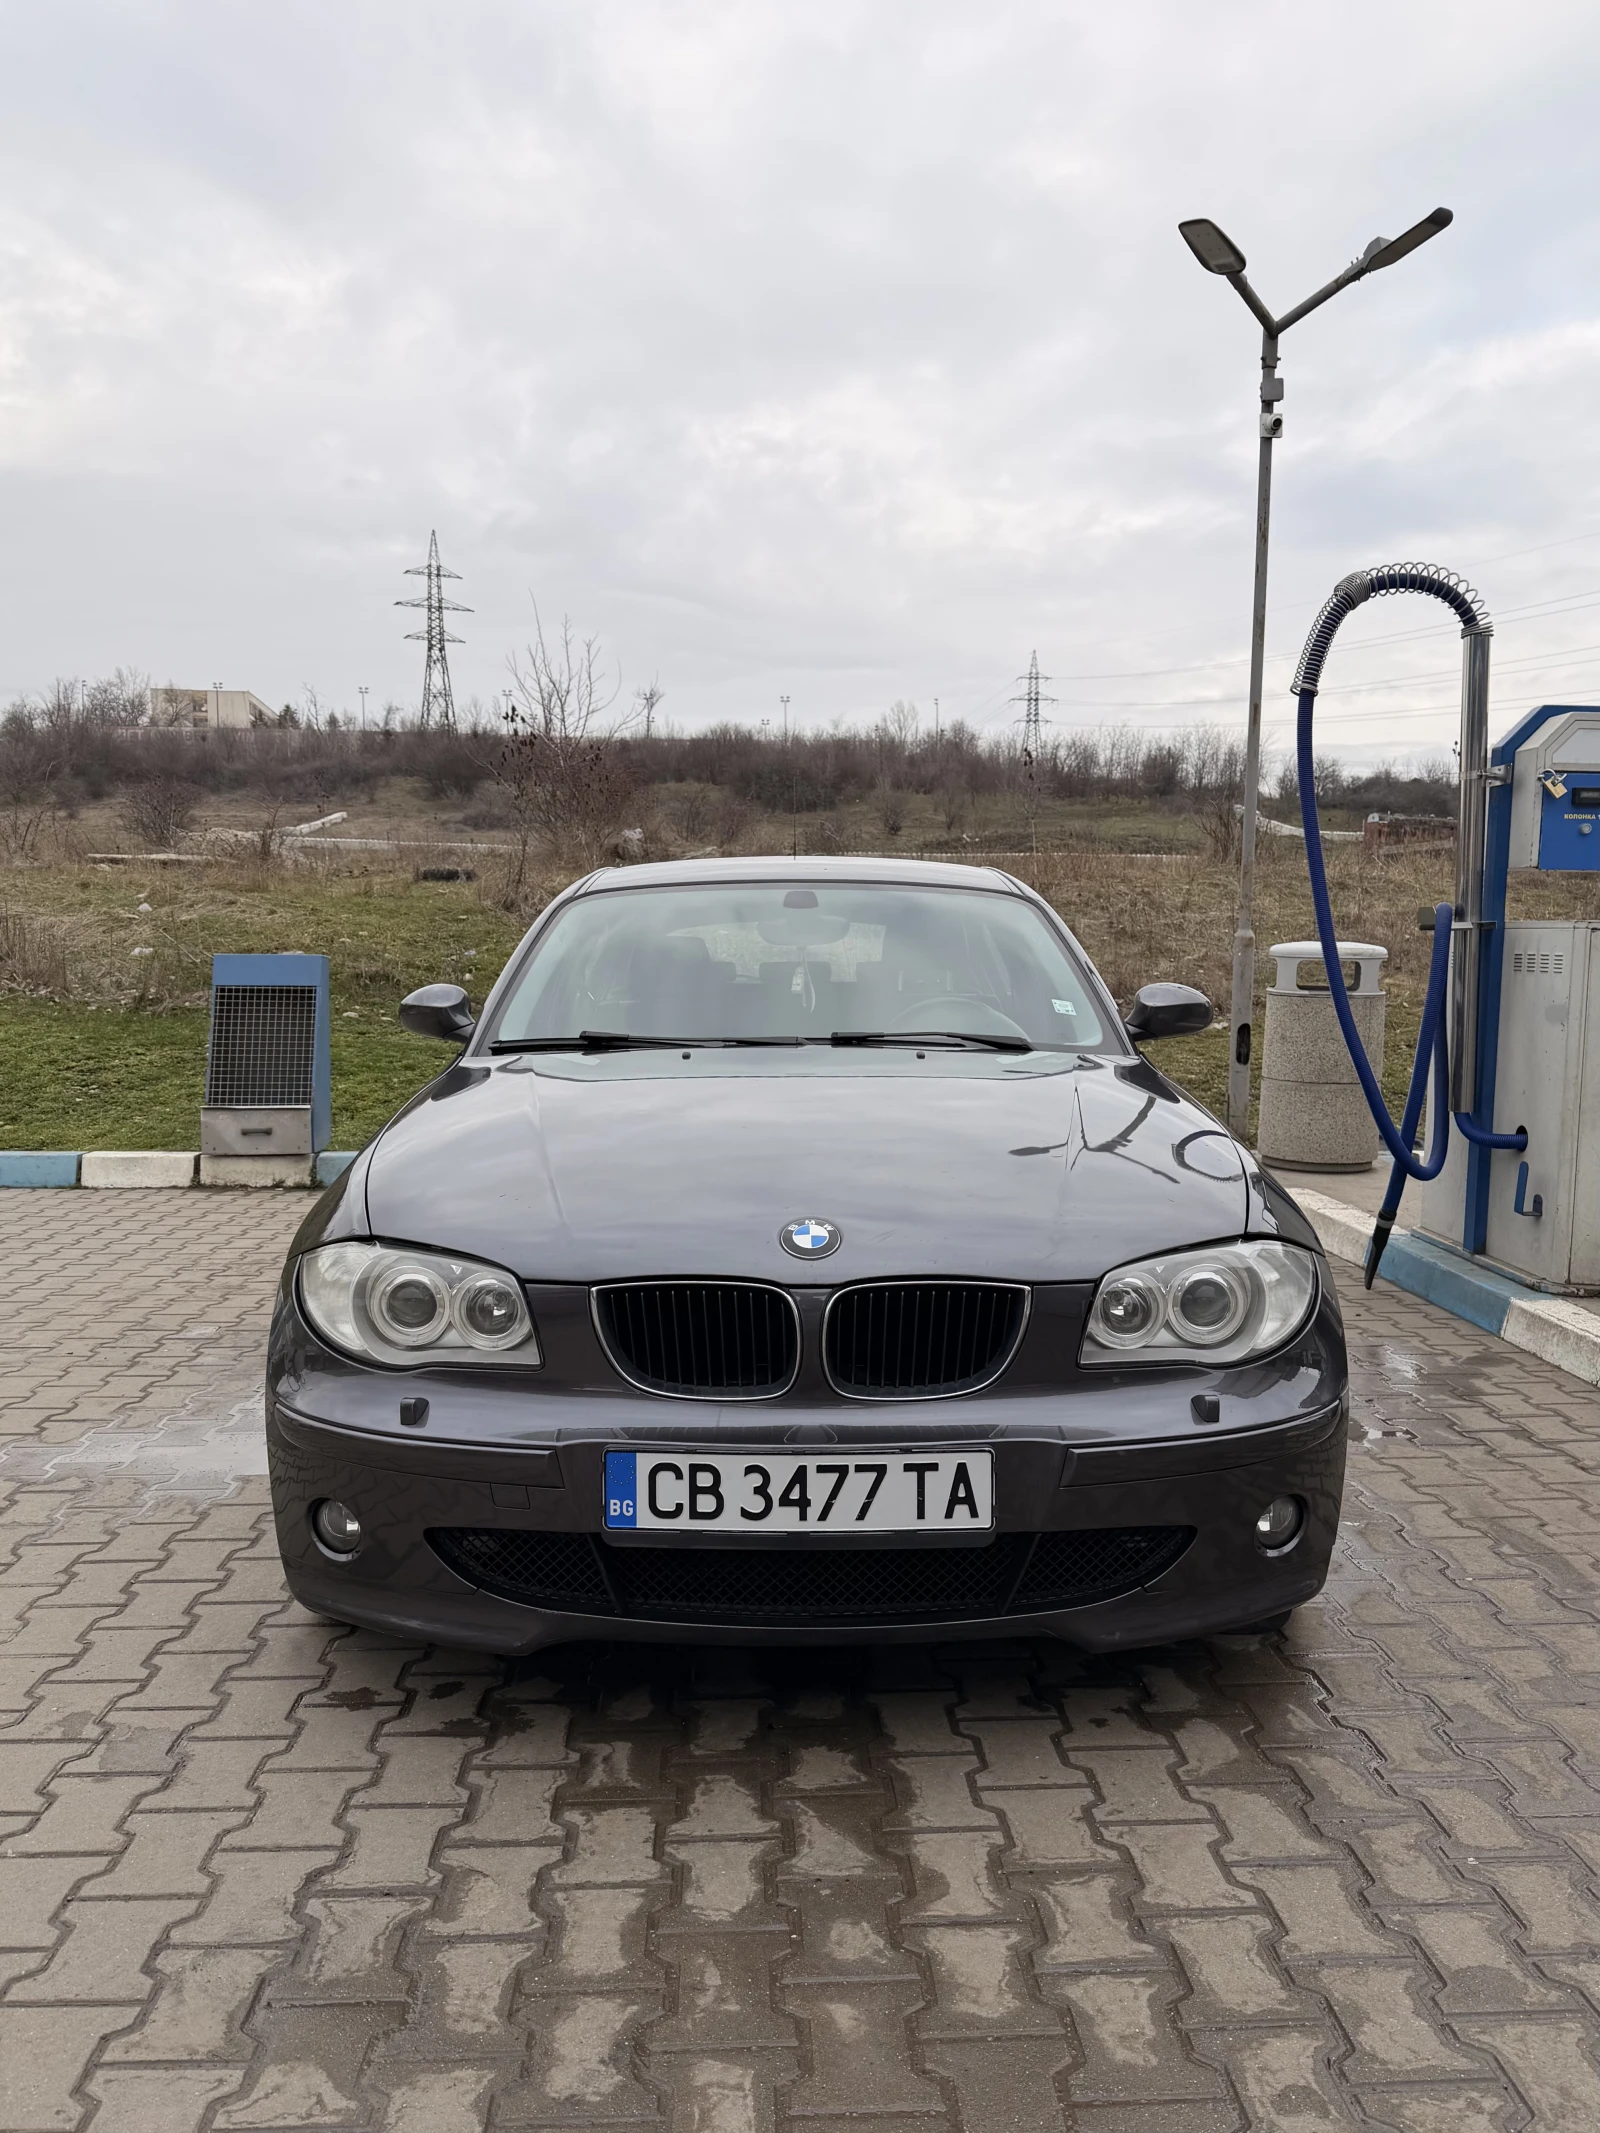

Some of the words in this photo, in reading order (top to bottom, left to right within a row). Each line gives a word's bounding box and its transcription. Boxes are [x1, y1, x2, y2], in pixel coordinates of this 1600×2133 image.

[787, 1219, 835, 1231] BMW
[647, 1462, 725, 1520] CB
[740, 1463, 888, 1521] 3477
[903, 1462, 980, 1520] TA
[609, 1499, 634, 1517] BG
